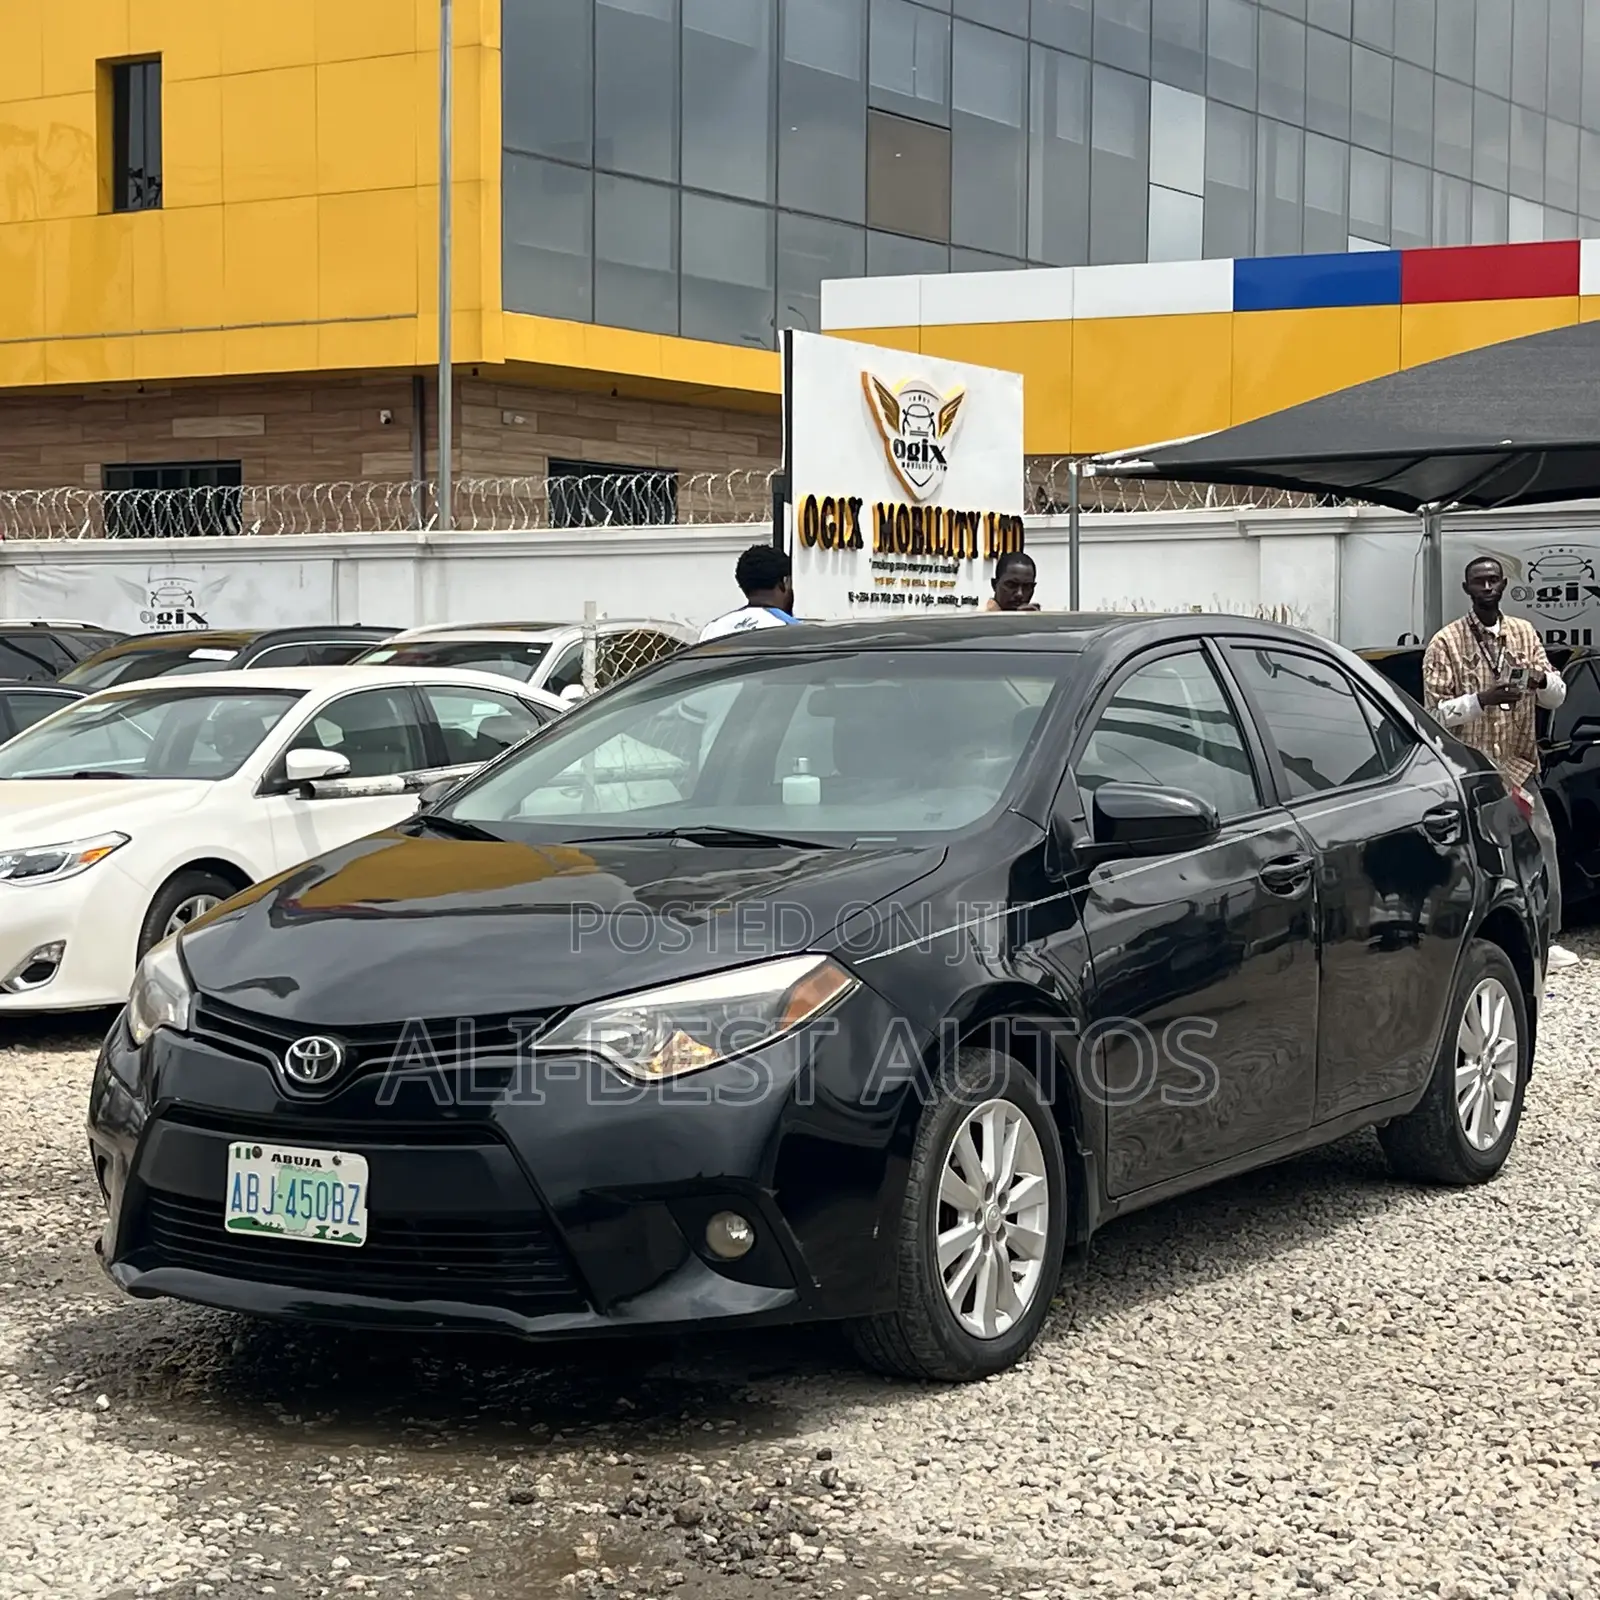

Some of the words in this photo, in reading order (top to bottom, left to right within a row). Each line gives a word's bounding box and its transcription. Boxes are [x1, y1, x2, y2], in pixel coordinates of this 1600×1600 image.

[798, 494, 864, 549] OGIX
[872, 502, 981, 559] MOBILITY
[983, 511, 1024, 560] LTD
[271, 1153, 322, 1168] ABUJA
[231, 1171, 360, 1226] ABJ-450BZ
